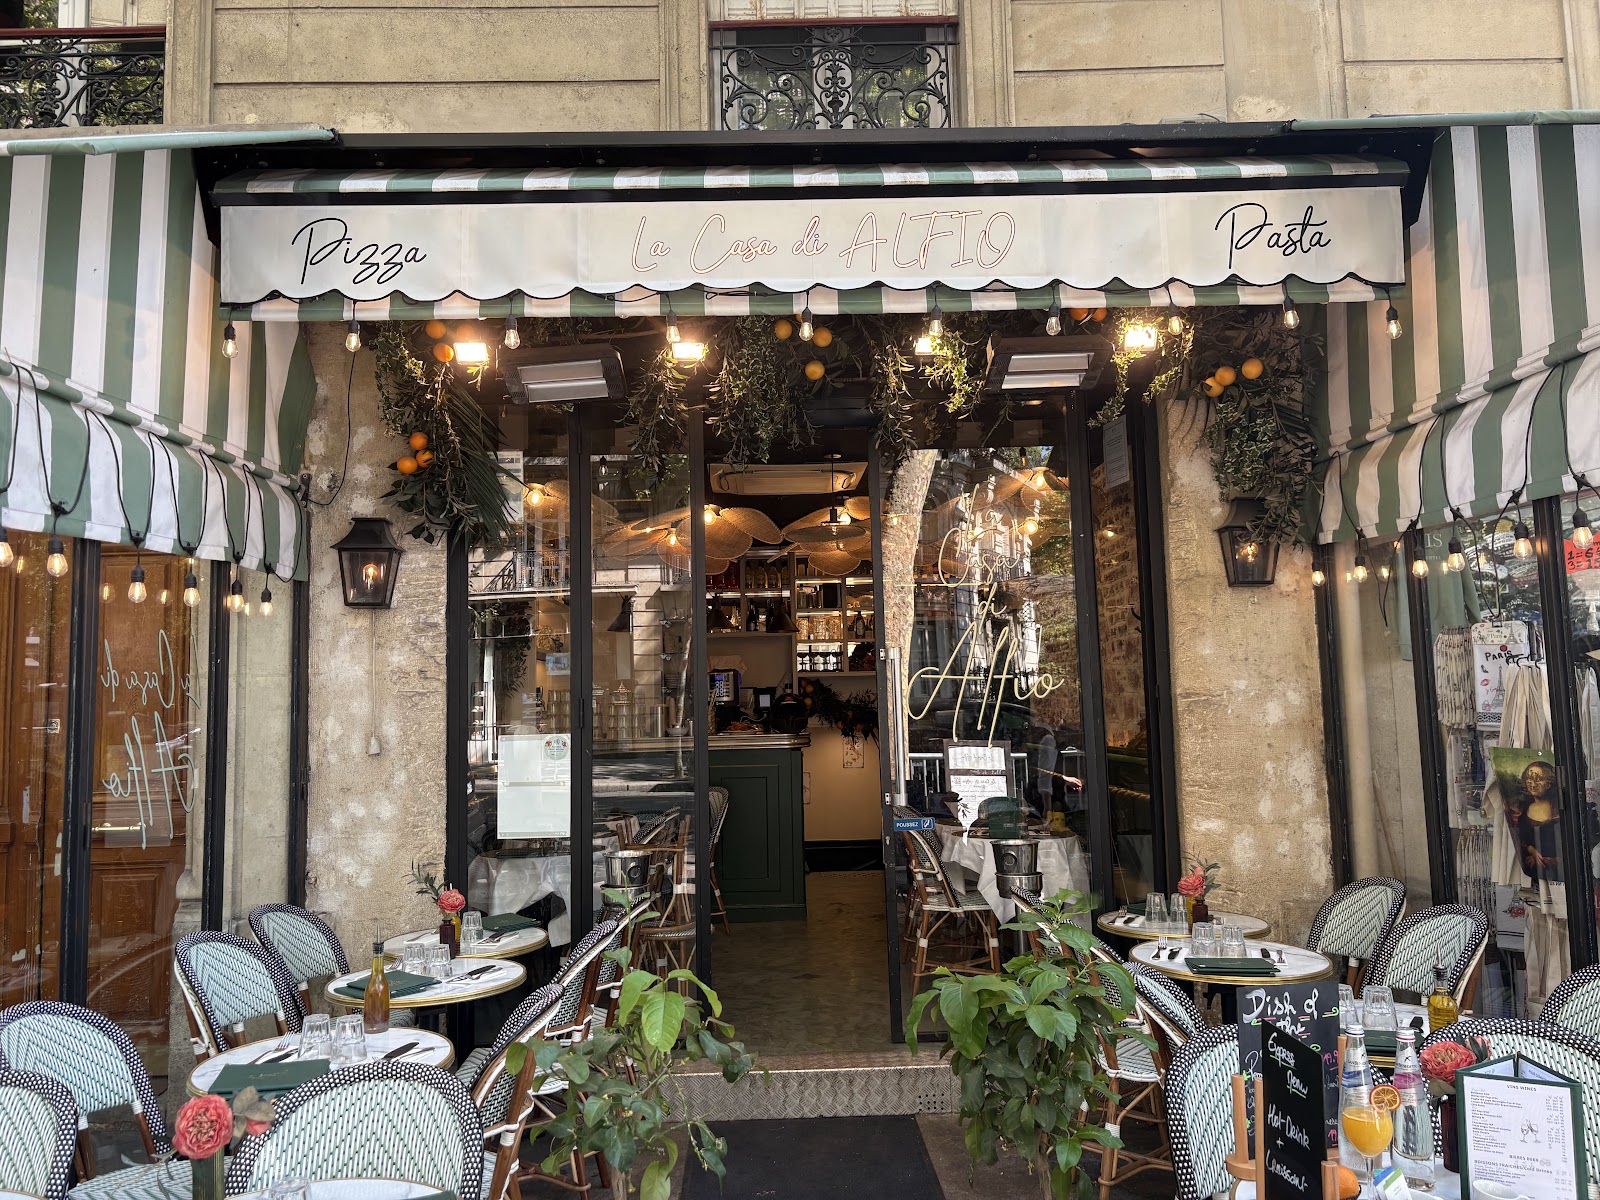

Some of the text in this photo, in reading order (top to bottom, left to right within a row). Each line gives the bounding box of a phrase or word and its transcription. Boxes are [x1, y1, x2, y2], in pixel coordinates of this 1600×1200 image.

[292, 217, 427, 285] Pizza
[631, 215, 671, 272] La
[689, 213, 778, 275] Casa
[792, 215, 828, 256] di
[1215, 203, 1332, 270] Pasta
[938, 526, 1023, 587] Casa
[977, 581, 1007, 635] di
[907, 620, 1064, 749] Alfio
[1484, 650, 1513, 662] PARIS
[1242, 987, 1297, 1024] Dish
[1474, 1159, 1499, 1167] BOISSONS
